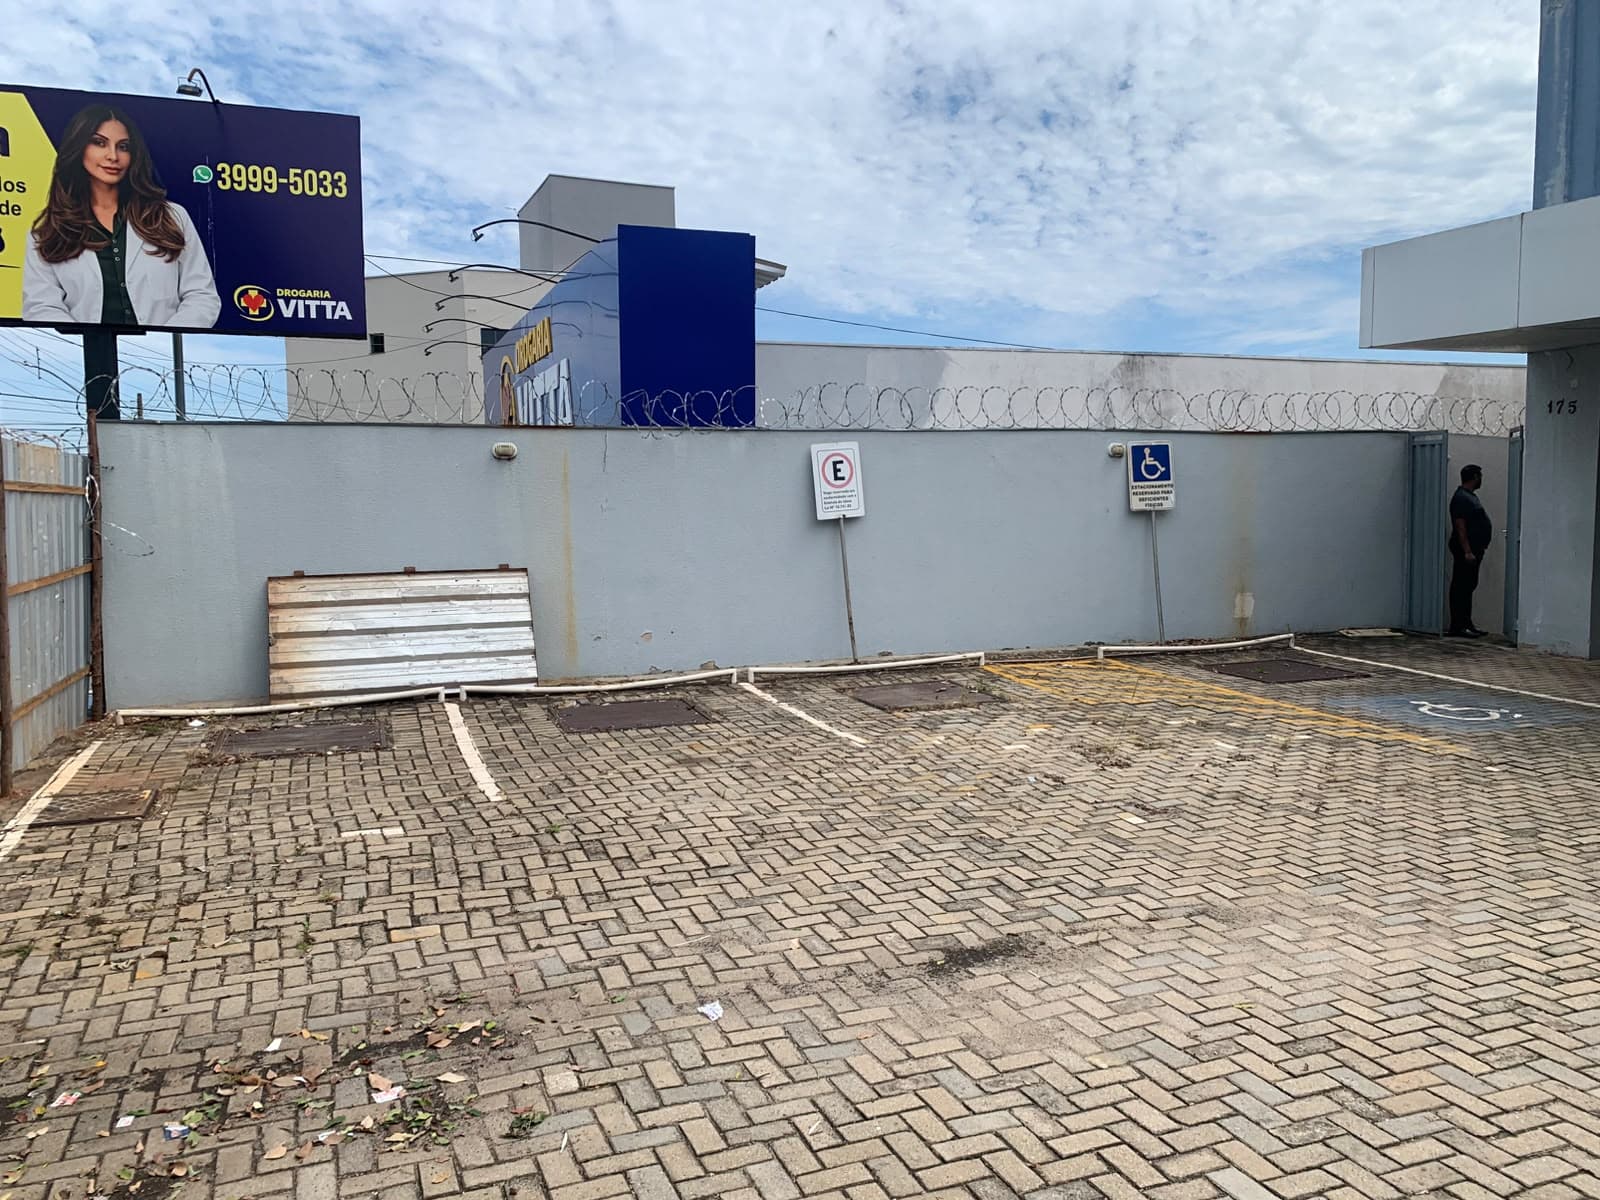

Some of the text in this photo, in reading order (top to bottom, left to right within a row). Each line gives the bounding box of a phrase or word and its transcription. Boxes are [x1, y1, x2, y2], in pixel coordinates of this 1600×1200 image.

[216, 163, 348, 198] 3999-5033
[276, 289, 331, 298] DROGARIA
[277, 299, 353, 320] VITTA
[515, 316, 552, 374] DROGARIA
[516, 358, 574, 426] VITTA
[1547, 398, 1578, 415] 175
[832, 460, 846, 480] E
